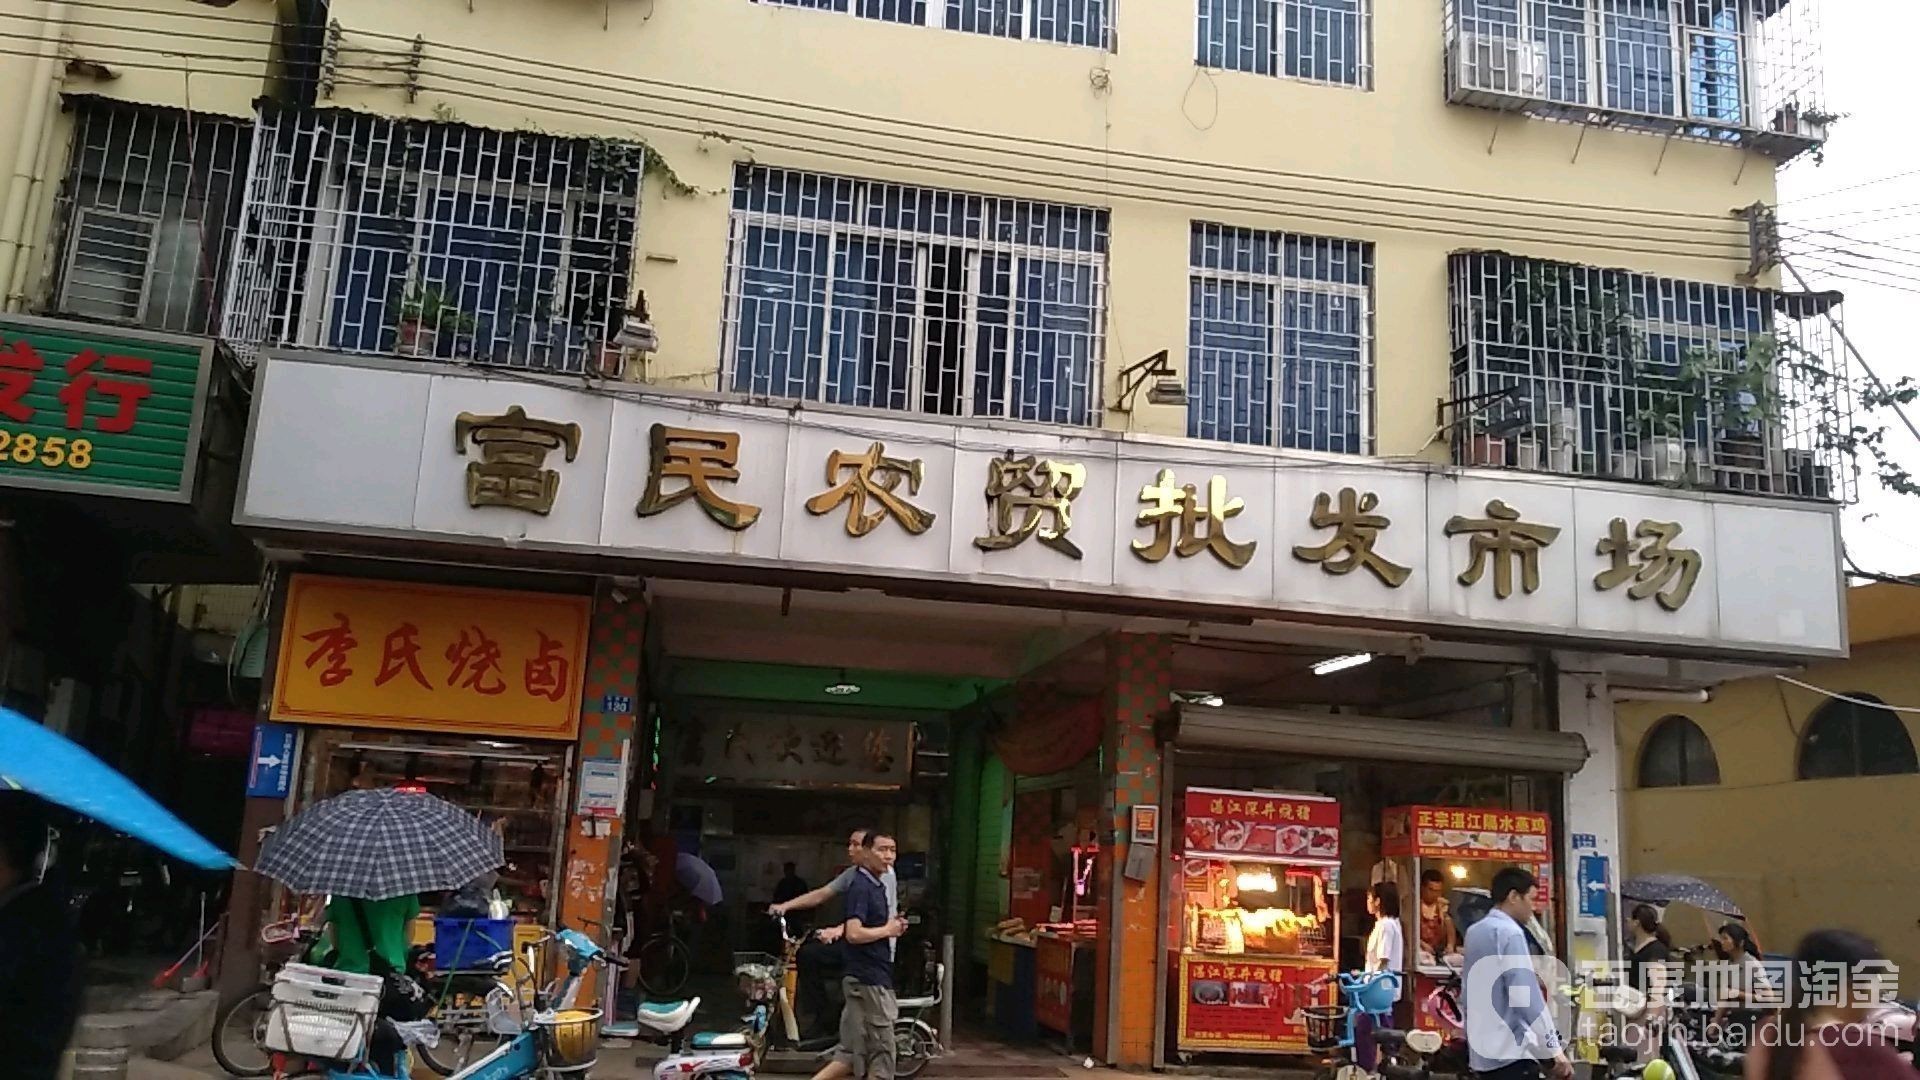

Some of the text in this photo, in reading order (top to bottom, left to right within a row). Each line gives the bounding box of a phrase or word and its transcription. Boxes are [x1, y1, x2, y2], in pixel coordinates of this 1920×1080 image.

[455, 405, 1702, 611] 富民农贸批发市场
[301, 612, 570, 703] 李氏烧卤
[1417, 810, 1547, 835] 正宗湛江隔水蒸鸡
